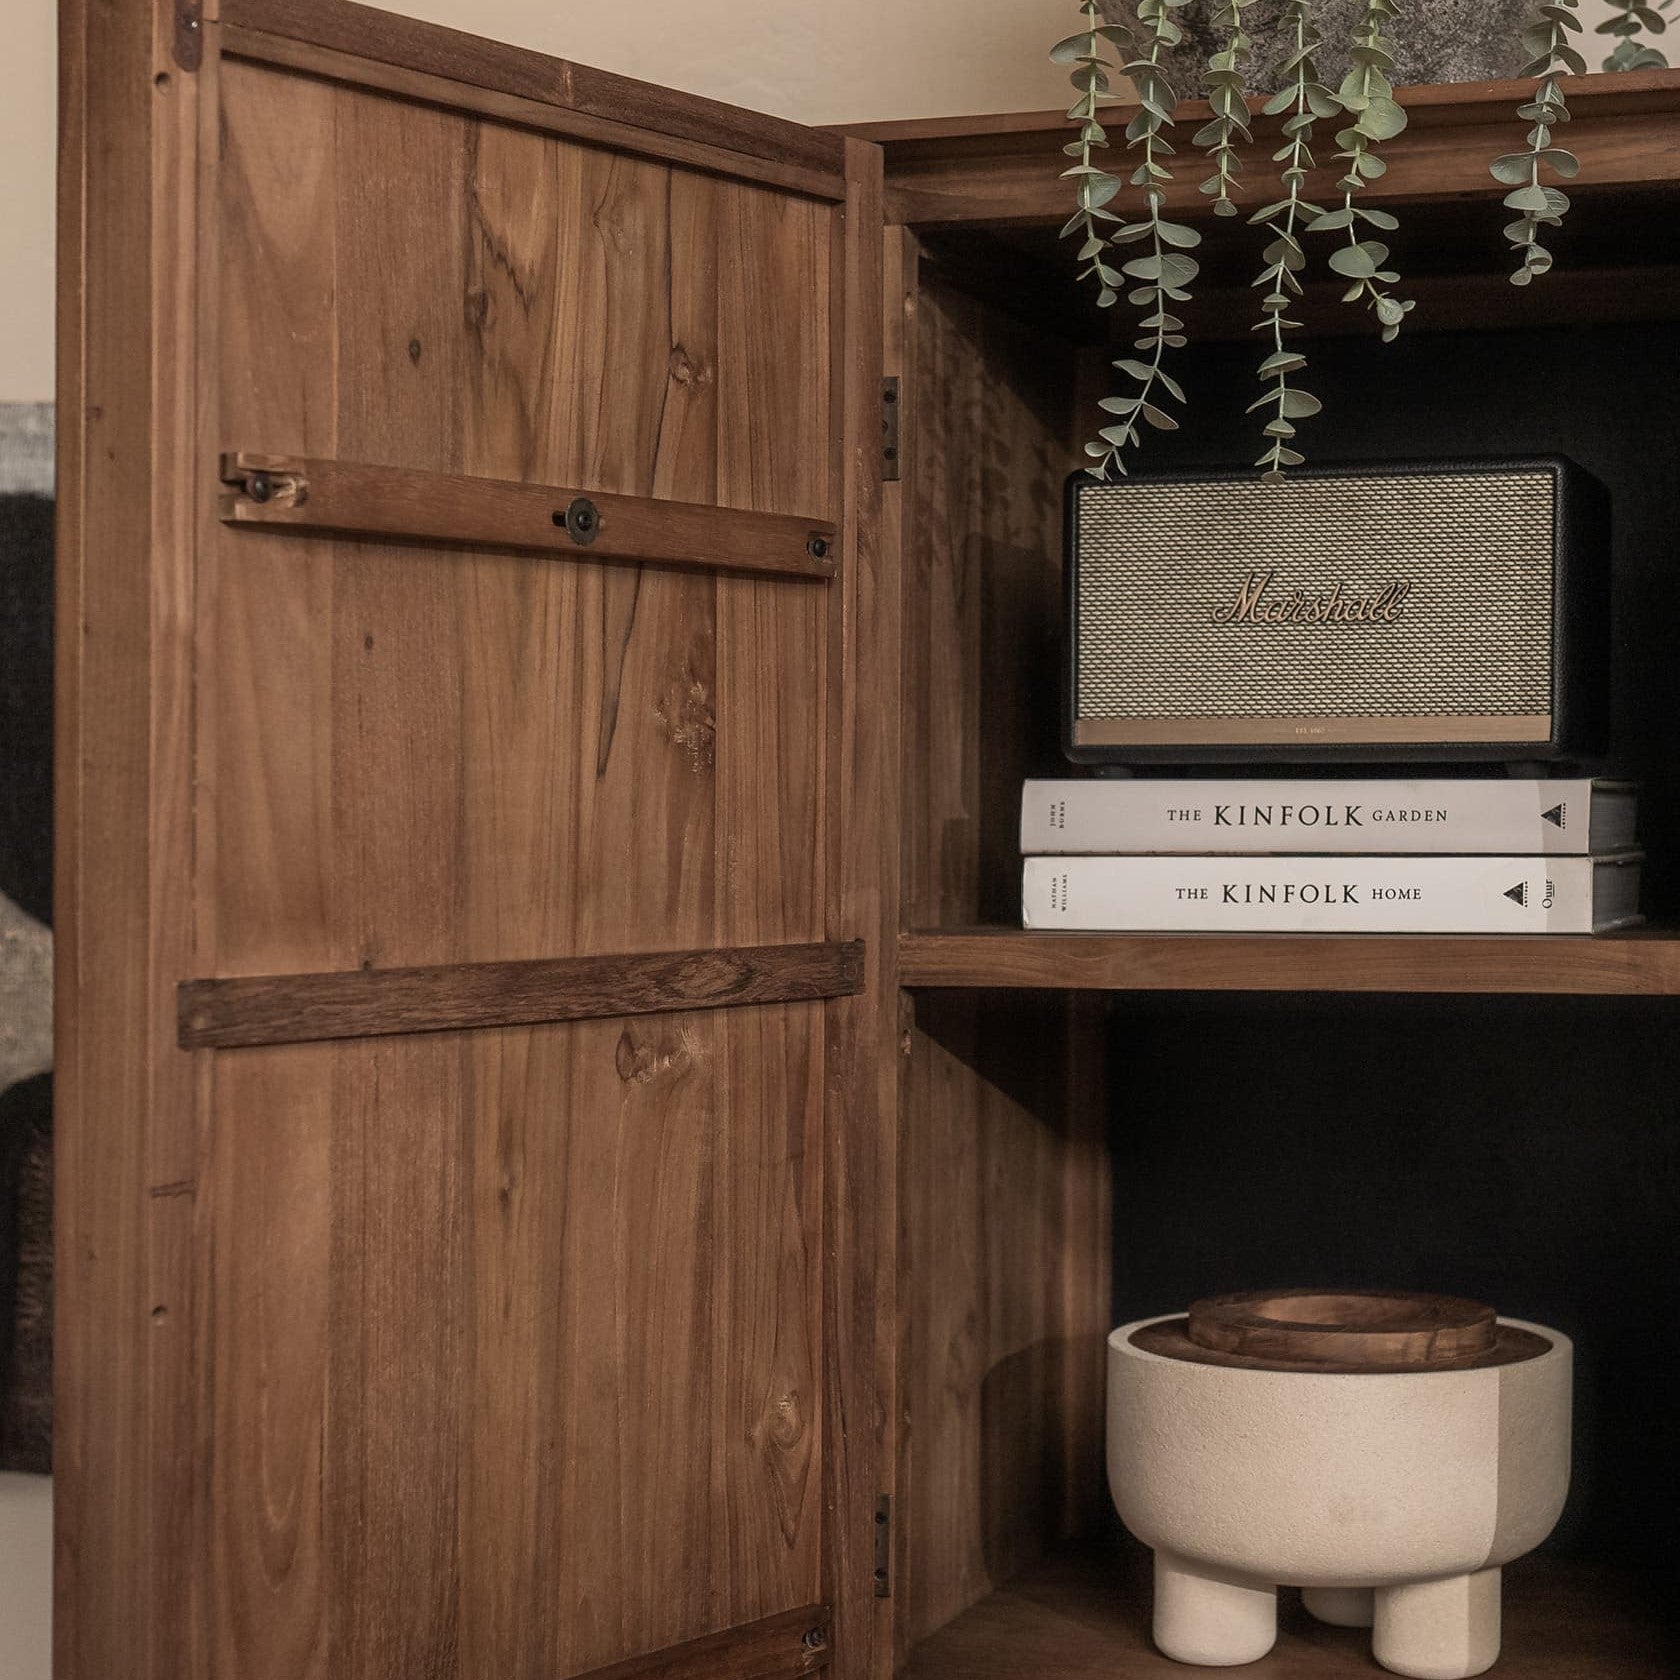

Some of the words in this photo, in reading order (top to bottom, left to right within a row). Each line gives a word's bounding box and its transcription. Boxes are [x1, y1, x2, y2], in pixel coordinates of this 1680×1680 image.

[1212, 572, 1411, 623] Marshall
[1167, 809, 1202, 821] THE
[1213, 805, 1363, 826] KINFOLK
[1372, 809, 1447, 821] GARDEN
[1175, 888, 1209, 900] THE
[1222, 884, 1359, 903] KINFOLK
[1372, 888, 1421, 900] HOME
[1542, 879, 1552, 908] Ouur
